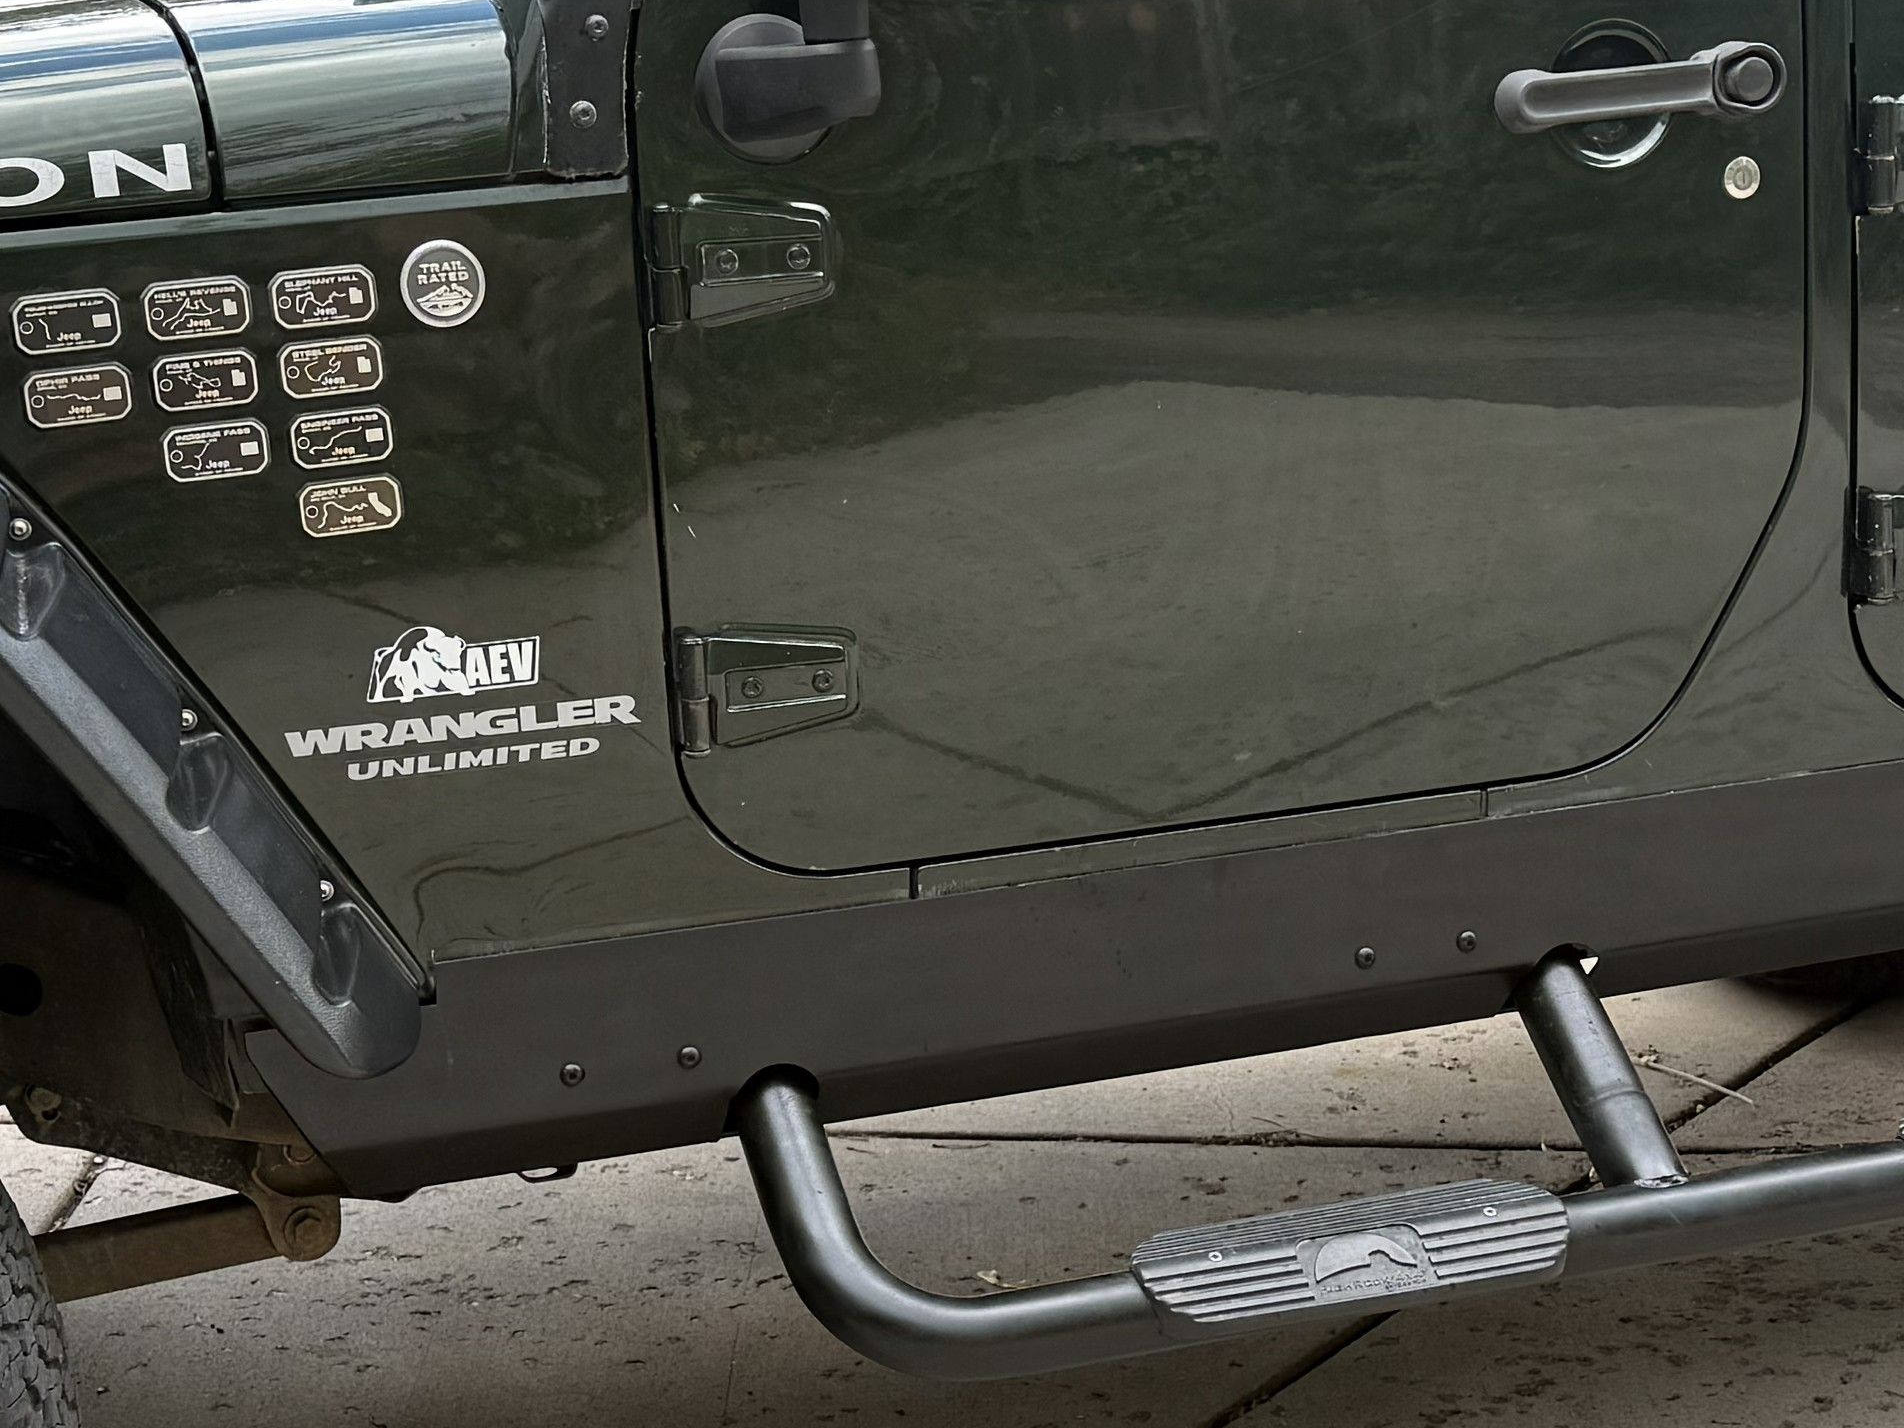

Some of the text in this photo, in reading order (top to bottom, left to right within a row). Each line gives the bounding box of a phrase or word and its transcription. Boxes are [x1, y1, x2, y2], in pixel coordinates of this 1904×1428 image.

[419, 260, 467, 274] TRAIL
[417, 272, 469, 285] RATED
[70, 373, 100, 384] PASS
[68, 404, 93, 415] Jeep
[351, 413, 379, 424] PASS
[223, 427, 251, 437] PASS
[205, 459, 230, 470] Jeep
[466, 639, 535, 687] AEV
[283, 694, 642, 759] WRANGLER
[346, 736, 601, 782] UNLIMITED
